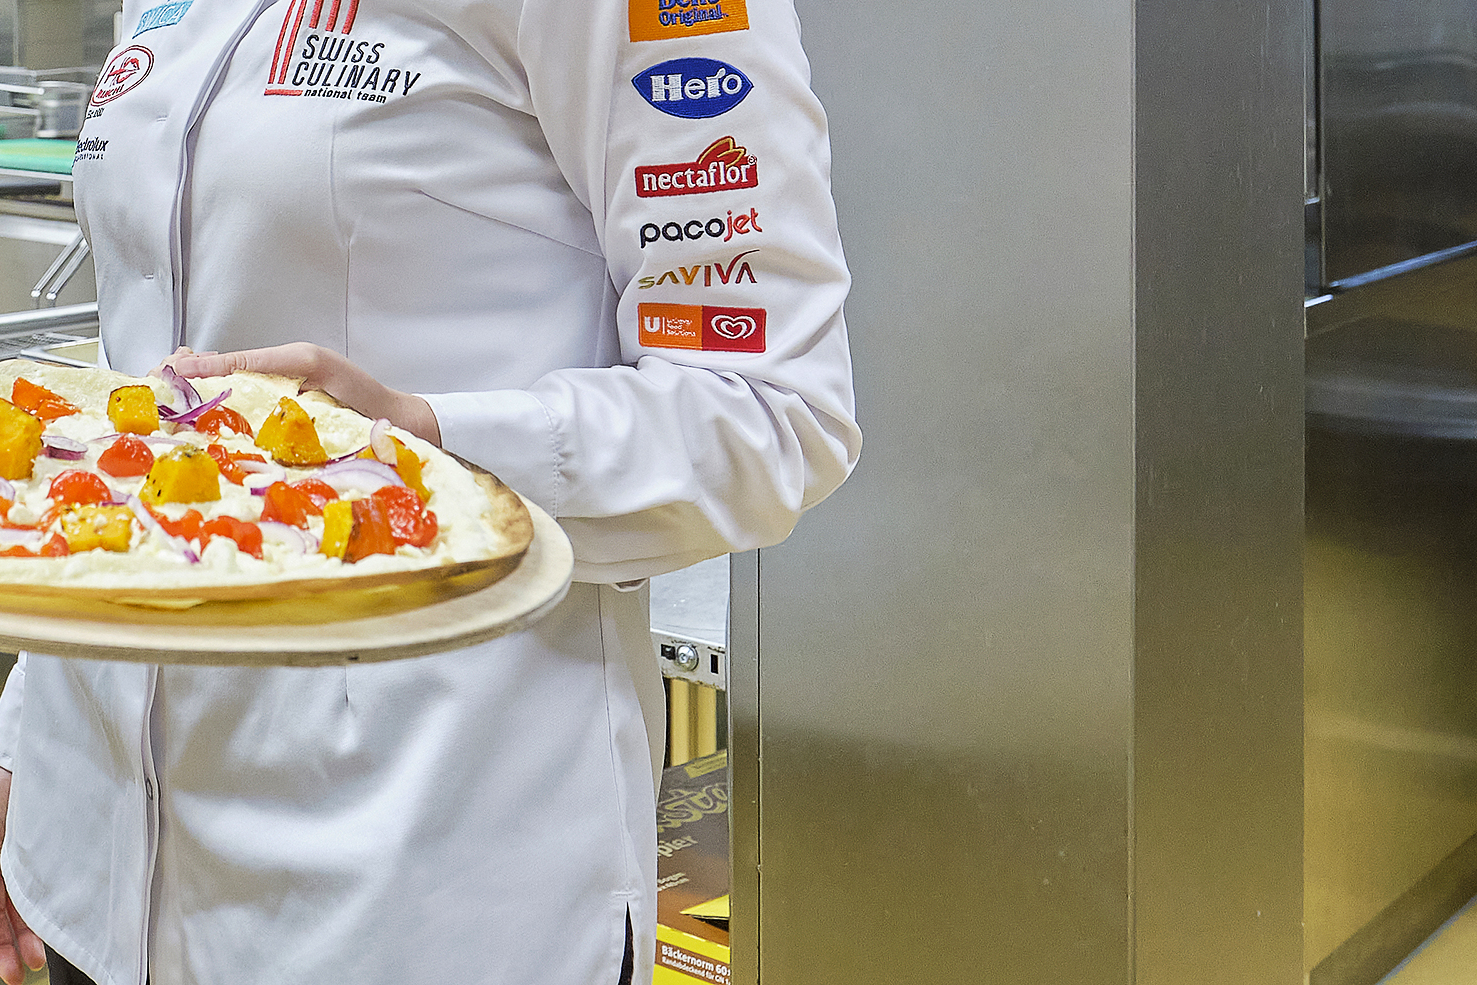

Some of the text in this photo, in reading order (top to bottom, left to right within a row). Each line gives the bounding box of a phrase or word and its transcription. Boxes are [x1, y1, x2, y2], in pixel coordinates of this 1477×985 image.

[301, 34, 385, 65] SWISS
[291, 61, 422, 96] CULINARY
[650, 67, 743, 102] Hero
[304, 88, 387, 105] national team
[642, 161, 751, 192] nectaflor
[639, 207, 763, 249] pacojet
[661, 945, 714, 972] Bäckernorm
